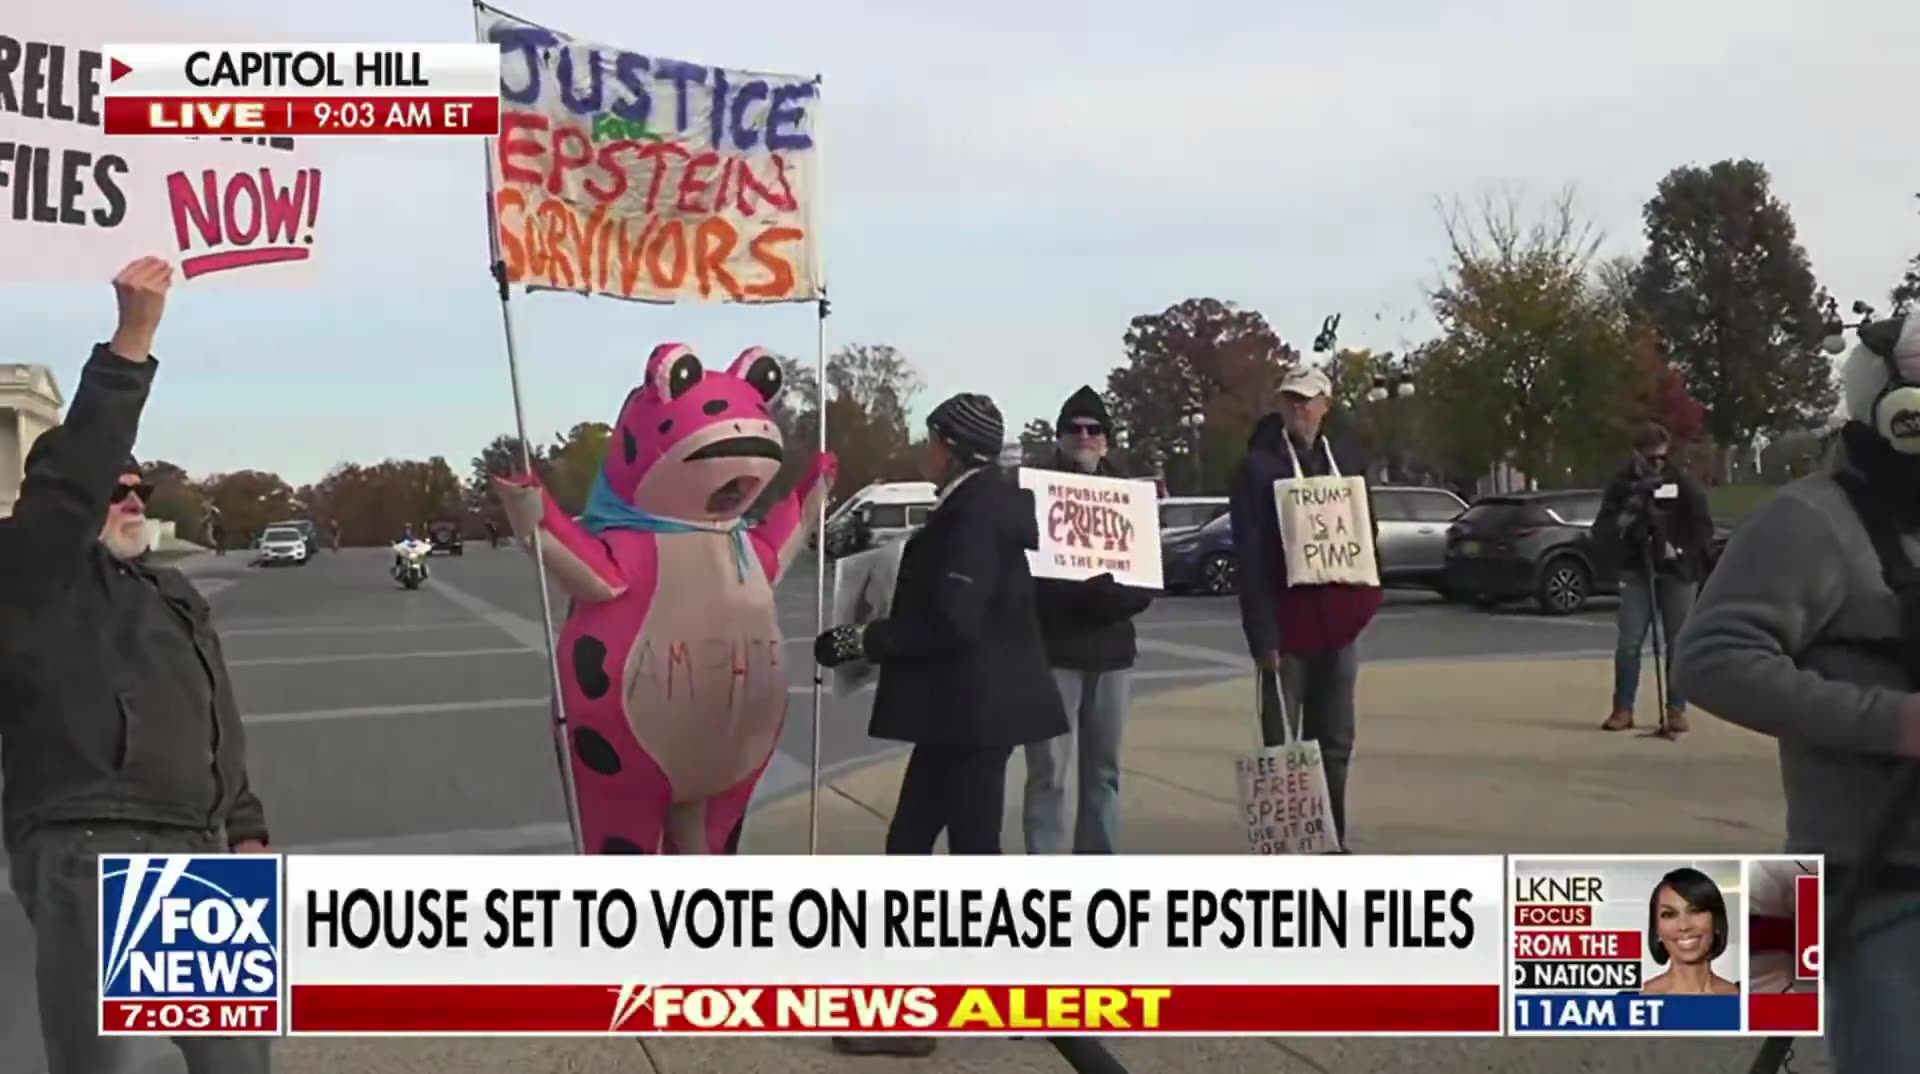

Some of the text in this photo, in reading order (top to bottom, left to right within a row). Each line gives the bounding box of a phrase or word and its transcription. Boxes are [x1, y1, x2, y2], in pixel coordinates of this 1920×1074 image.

[488, 26, 815, 151] JUSTICE
[498, 112, 798, 217] EPSTEIN
[167, 167, 321, 251] NOW!
[497, 187, 804, 299] SURVIVORS
[1047, 484, 1131, 505] REPUBLICAN
[1288, 487, 1352, 505] TRUMP
[1047, 500, 1136, 552] CRUELTY
[1336, 515, 1347, 535] A
[1054, 553, 1131, 571] IS THE POINT
[1303, 541, 1361, 569] PIMP
[1253, 772, 1309, 798] FREE
[1246, 796, 1324, 826] SPEECH
